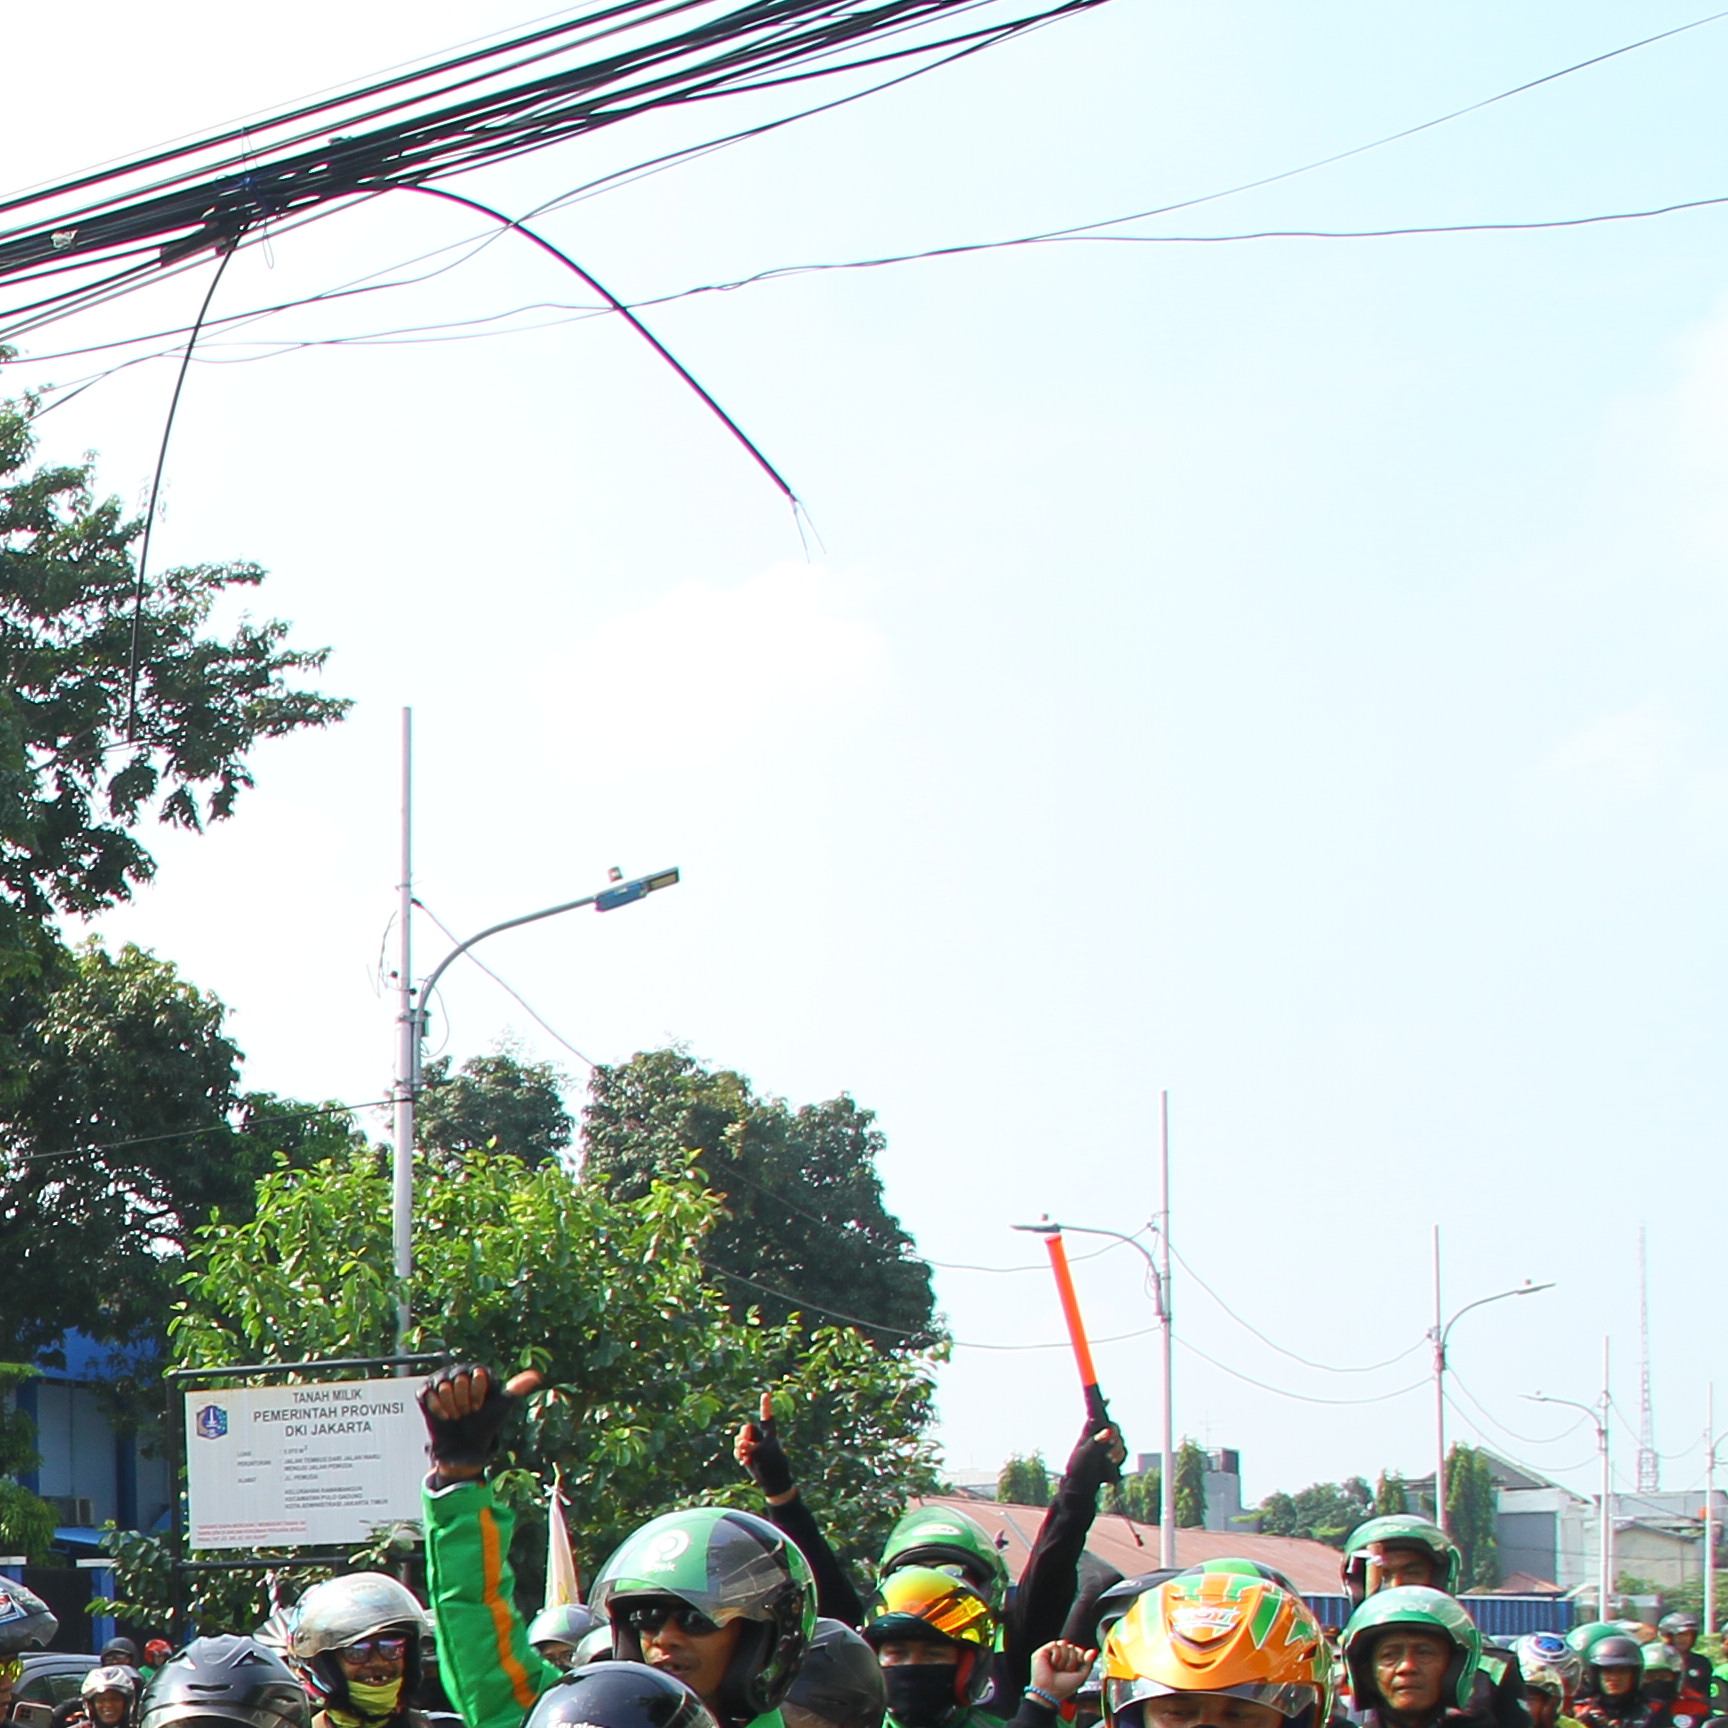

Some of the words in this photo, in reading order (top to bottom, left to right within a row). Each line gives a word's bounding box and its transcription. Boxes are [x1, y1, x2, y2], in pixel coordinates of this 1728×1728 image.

[293, 1390, 329, 1403] TANAH
[332, 1388, 362, 1401] MILIK
[253, 1407, 338, 1422] PEMERINTAH
[341, 1402, 404, 1418] PROVINSI
[285, 1425, 307, 1437] DKI
[311, 1421, 372, 1436] JAKARTA
